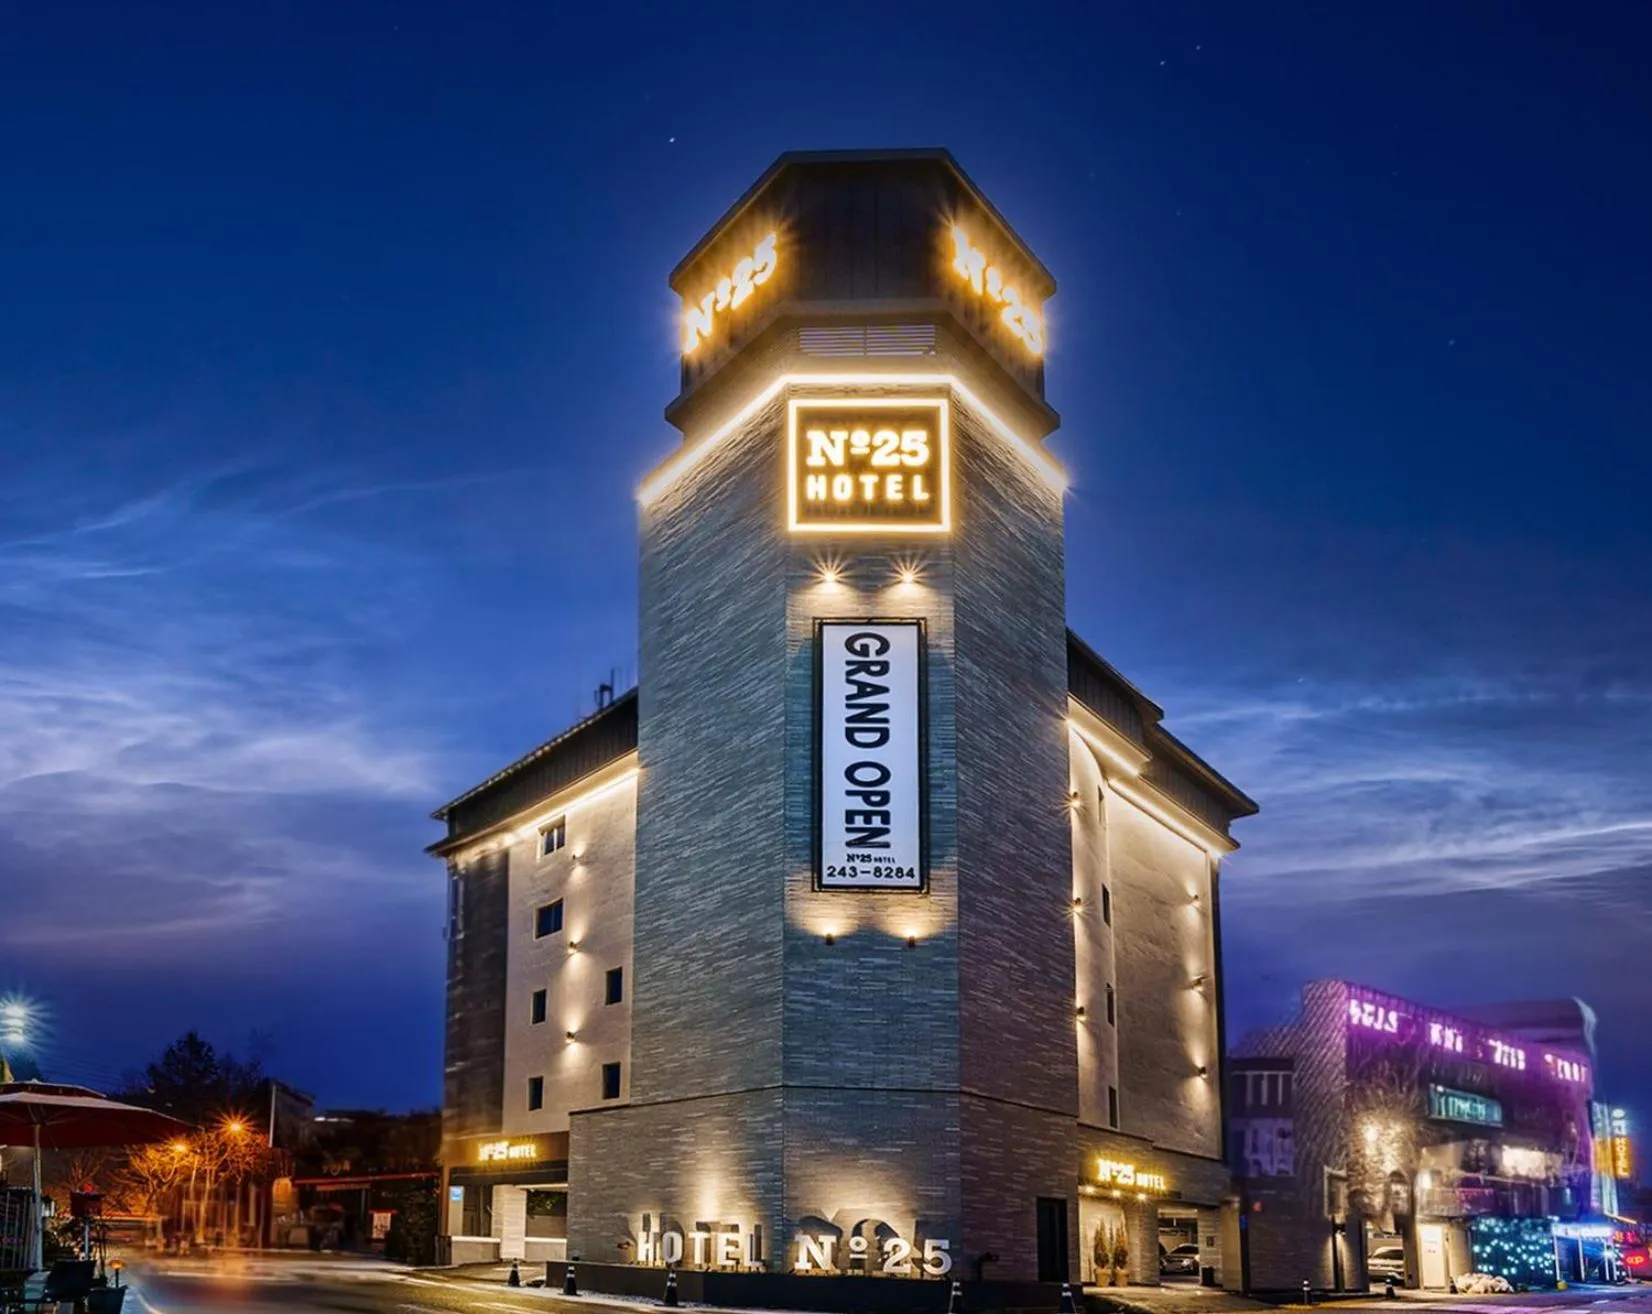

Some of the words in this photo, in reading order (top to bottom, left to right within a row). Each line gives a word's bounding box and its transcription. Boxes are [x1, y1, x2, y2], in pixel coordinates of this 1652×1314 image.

[806, 475, 930, 501] HOTEL
[844, 631, 891, 749] GRAND
[844, 760, 892, 849] OPEN
[827, 865, 915, 879] 243-8284
[637, 1230, 764, 1269] HOTEL
